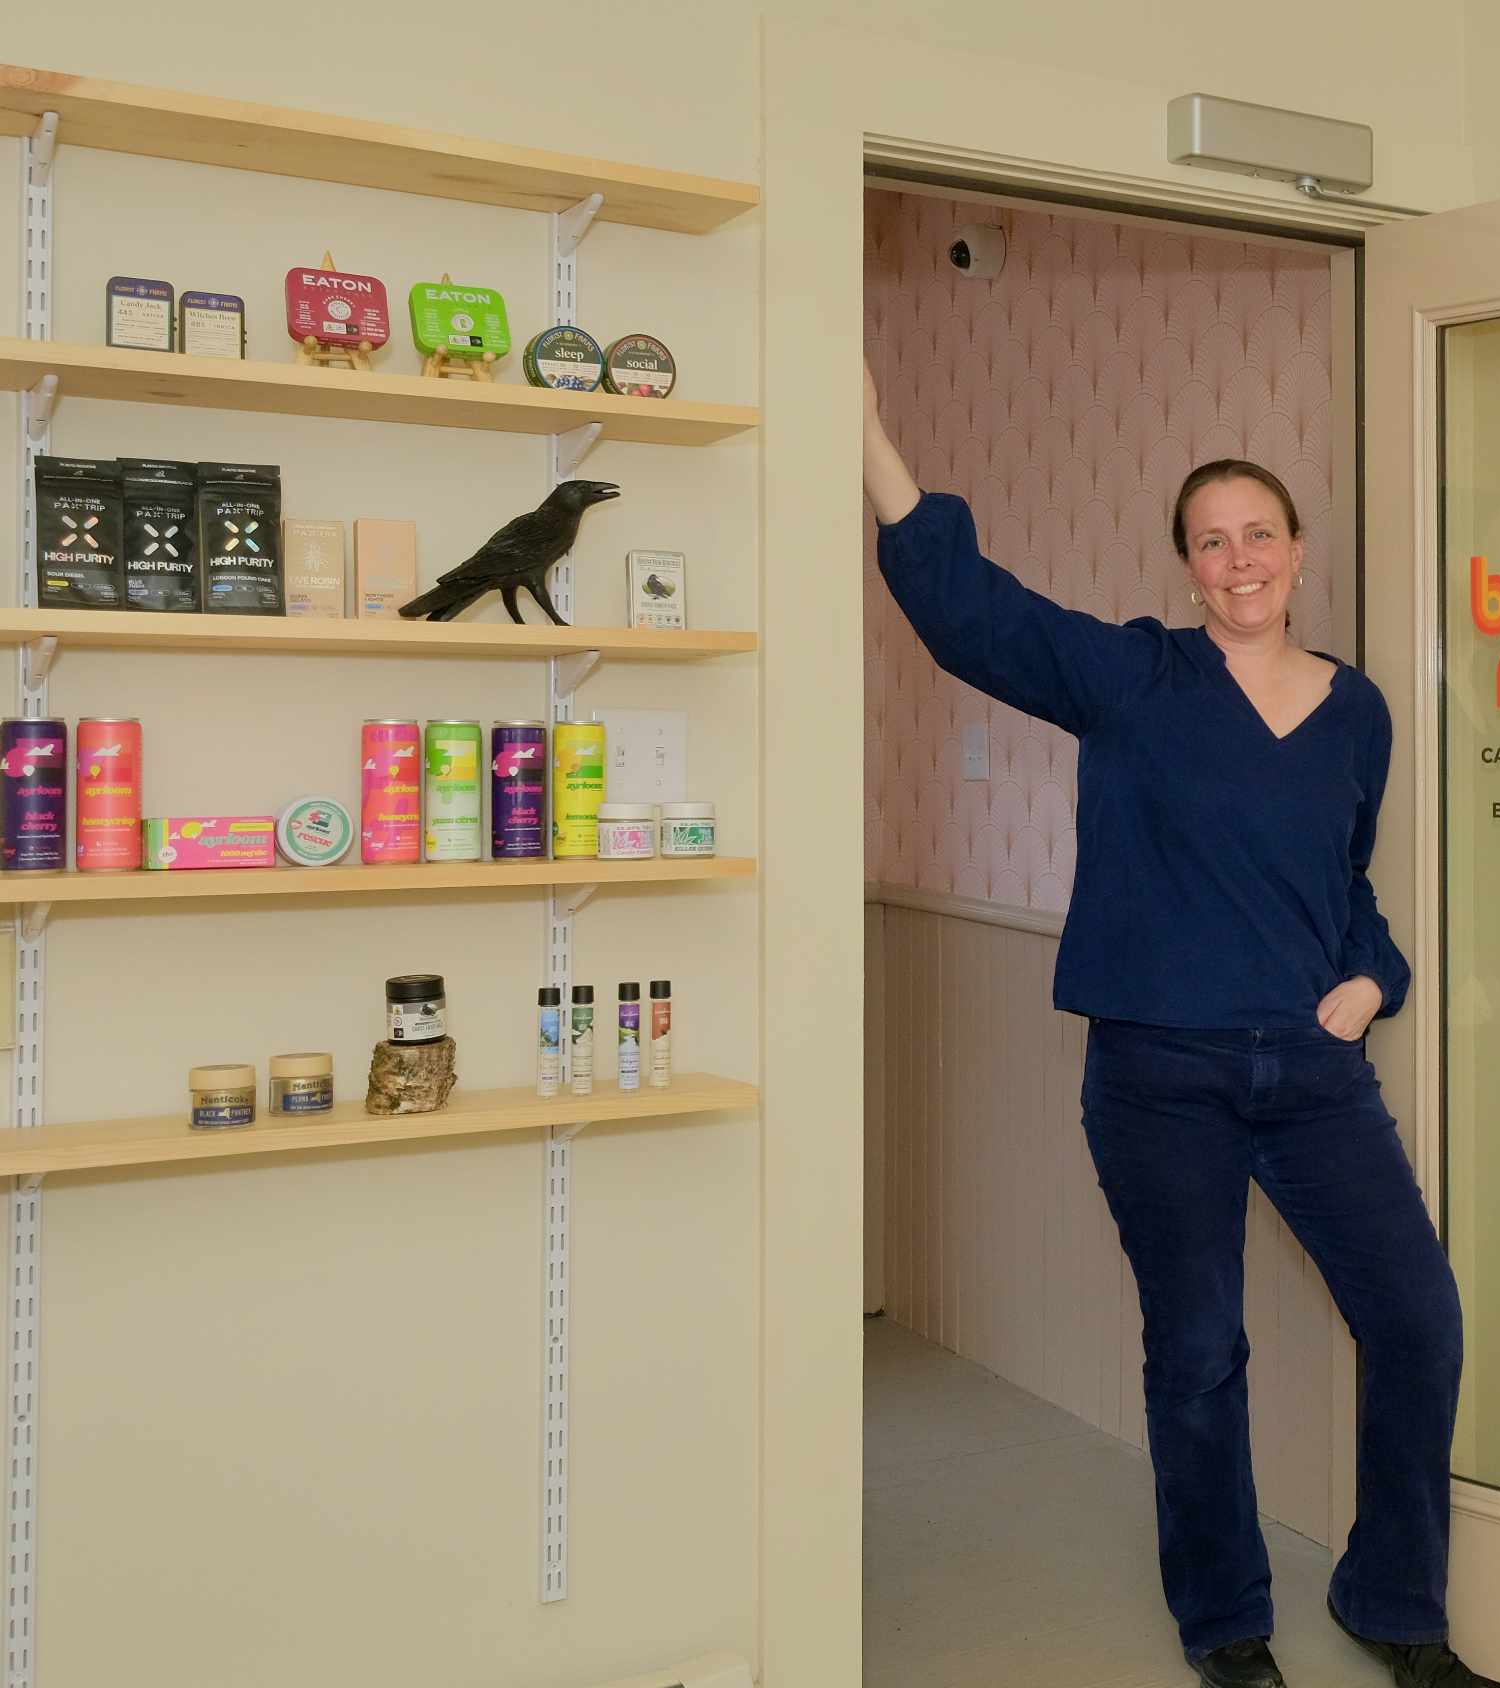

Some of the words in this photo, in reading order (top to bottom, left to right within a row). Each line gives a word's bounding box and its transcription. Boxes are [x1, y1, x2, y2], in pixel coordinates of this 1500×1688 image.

[302, 273, 372, 293] EATON
[425, 288, 491, 304] EATON
[555, 347, 584, 360] sleep
[626, 358, 658, 370] social
[166, 512, 186, 520] TRIP
[245, 508, 265, 516] TRIP
[44, 551, 74, 562] HIGH
[75, 552, 115, 565] PURITY
[210, 556, 237, 567] HIGH
[238, 556, 274, 568] PURITY
[128, 561, 156, 571] HIGH
[157, 561, 193, 573] PURITY
[21, 821, 57, 832] cherry
[508, 816, 539, 825] cherry
